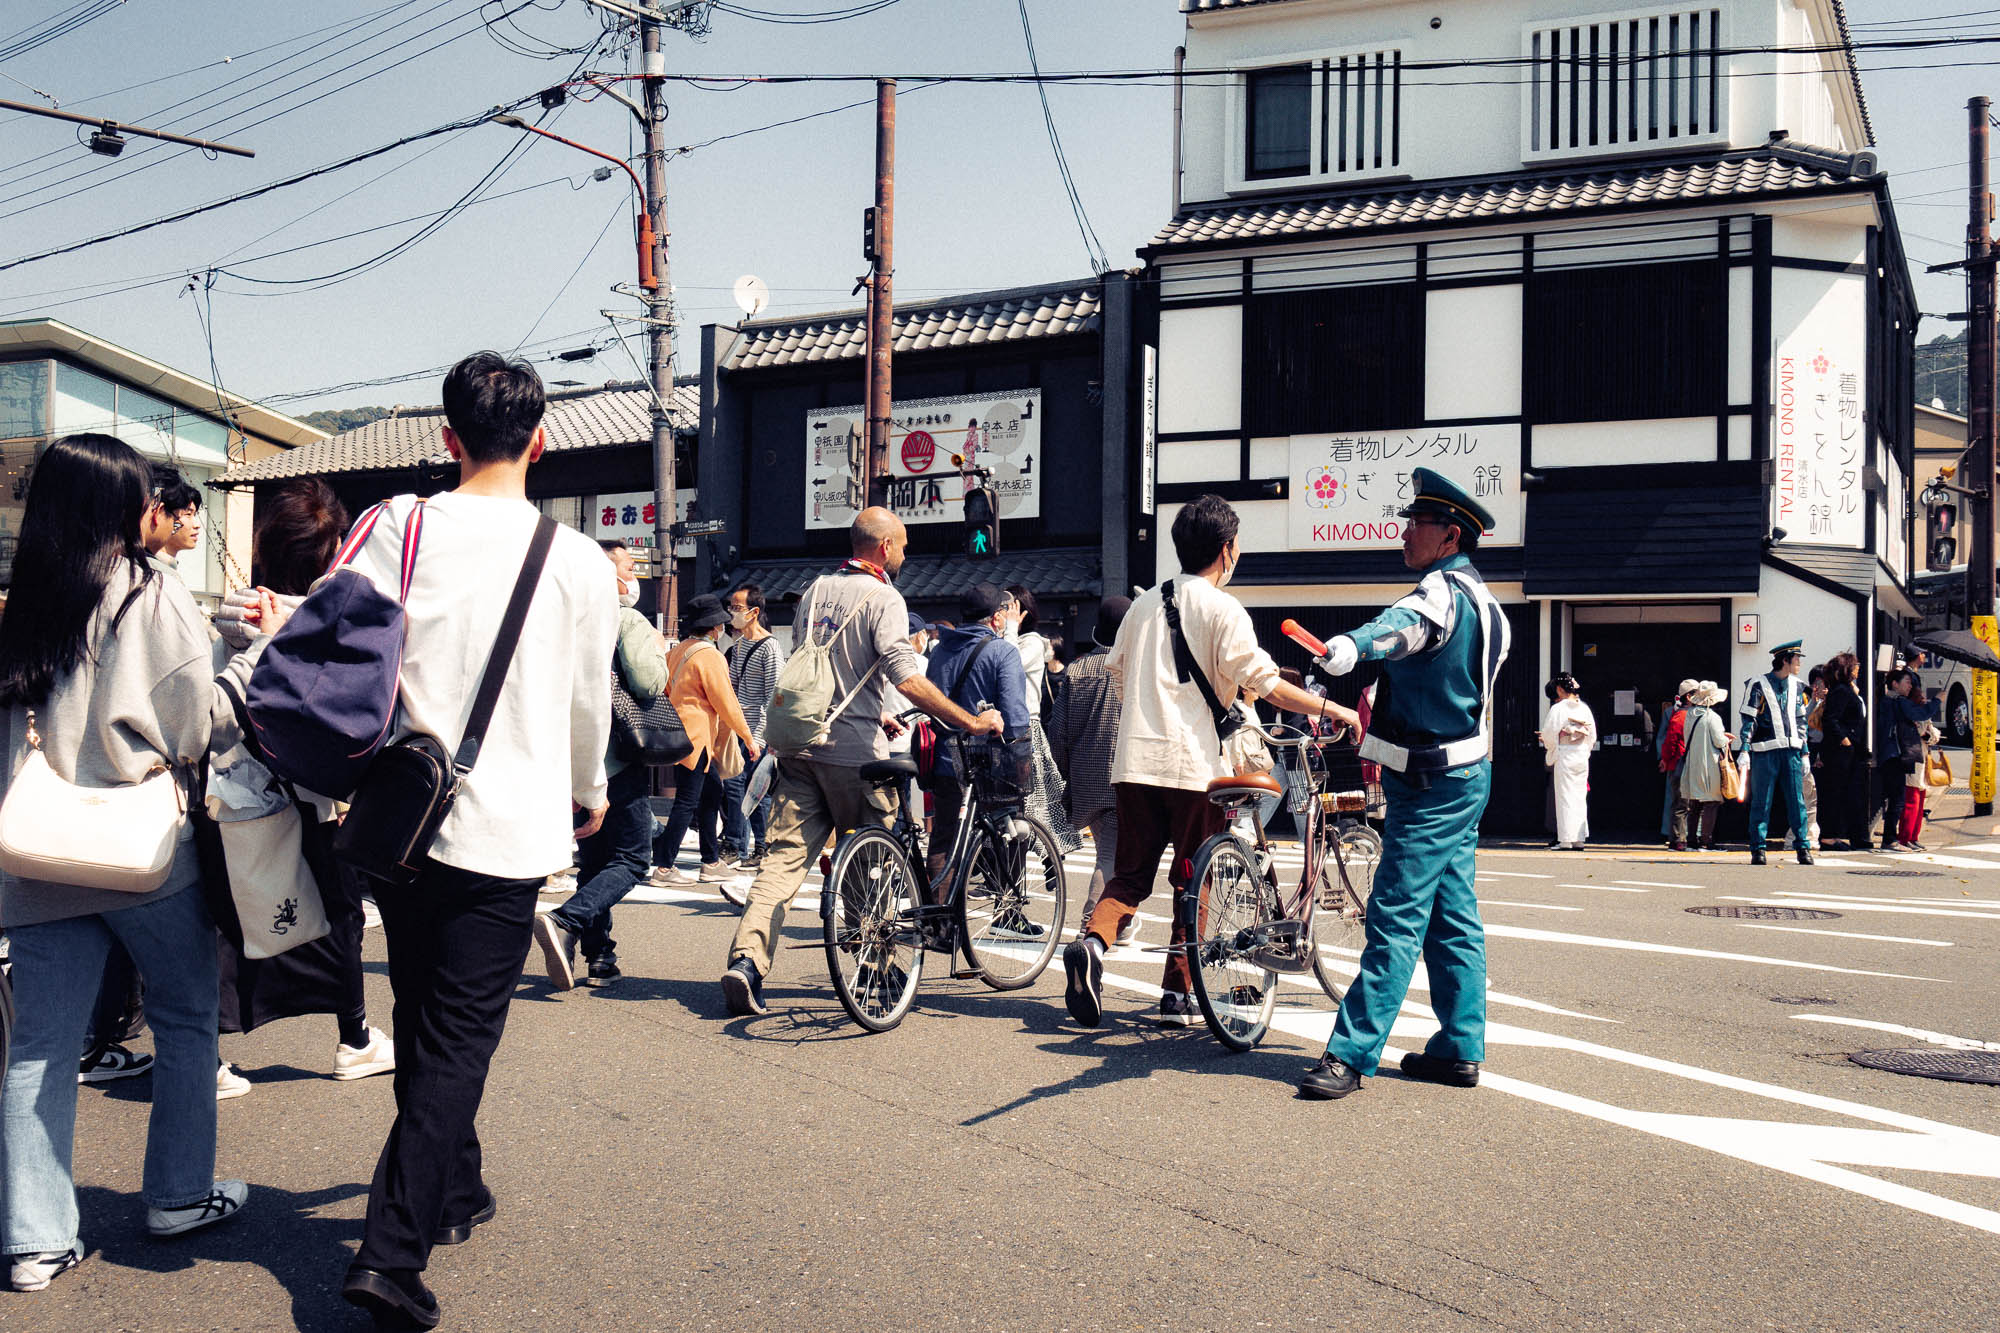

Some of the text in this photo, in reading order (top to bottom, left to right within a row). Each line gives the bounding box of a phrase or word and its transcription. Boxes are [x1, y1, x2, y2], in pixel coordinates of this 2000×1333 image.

[1330, 432, 1478, 463] 着物レンタル
[1780, 357, 1794, 521] KIMONO RENTAL
[1838, 372, 1857, 514] 着物レンタル
[1356, 463, 1504, 501] ぎを錦
[1313, 521, 1399, 541] KIMONO
